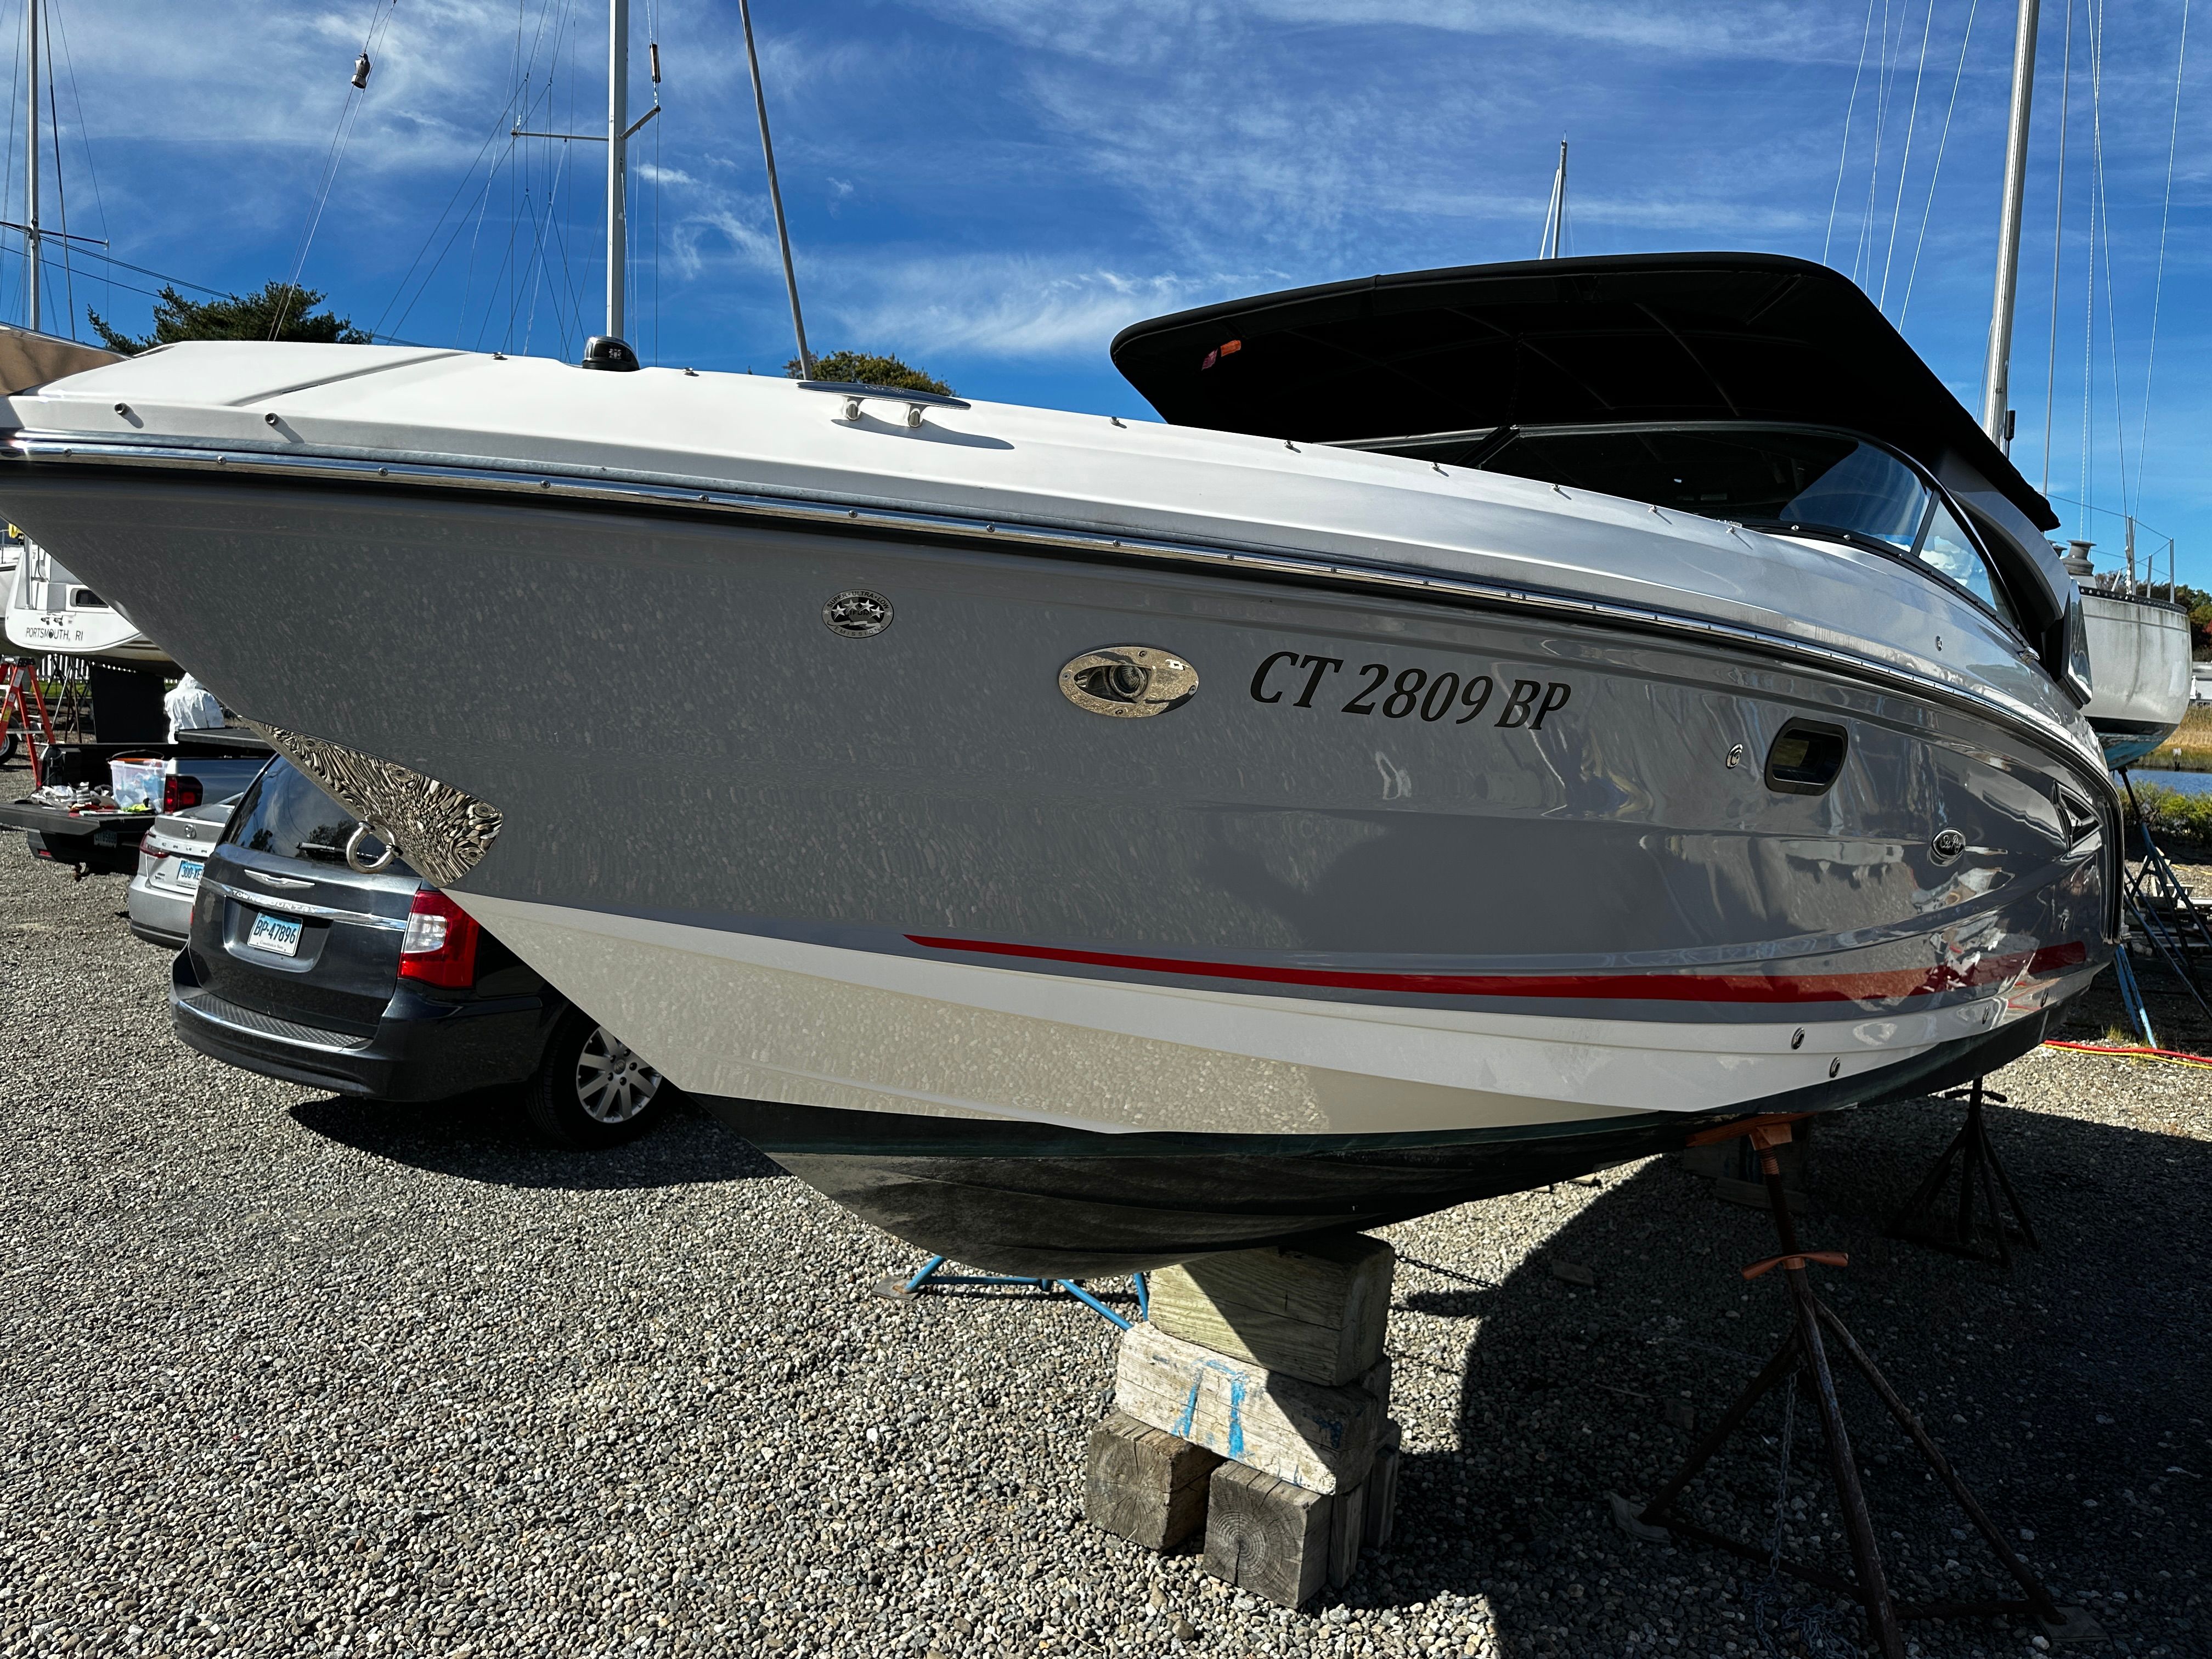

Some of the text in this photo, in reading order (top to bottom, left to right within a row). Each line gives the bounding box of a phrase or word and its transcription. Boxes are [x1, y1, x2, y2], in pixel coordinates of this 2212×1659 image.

[827, 593, 848, 608] SUPER
[877, 597, 890, 609] LOW
[75, 630, 83, 641] RI
[834, 625, 880, 636] EMISSION
[1250, 651, 1571, 730] CT 2809 BP
[253, 919, 297, 944] BP-47896
